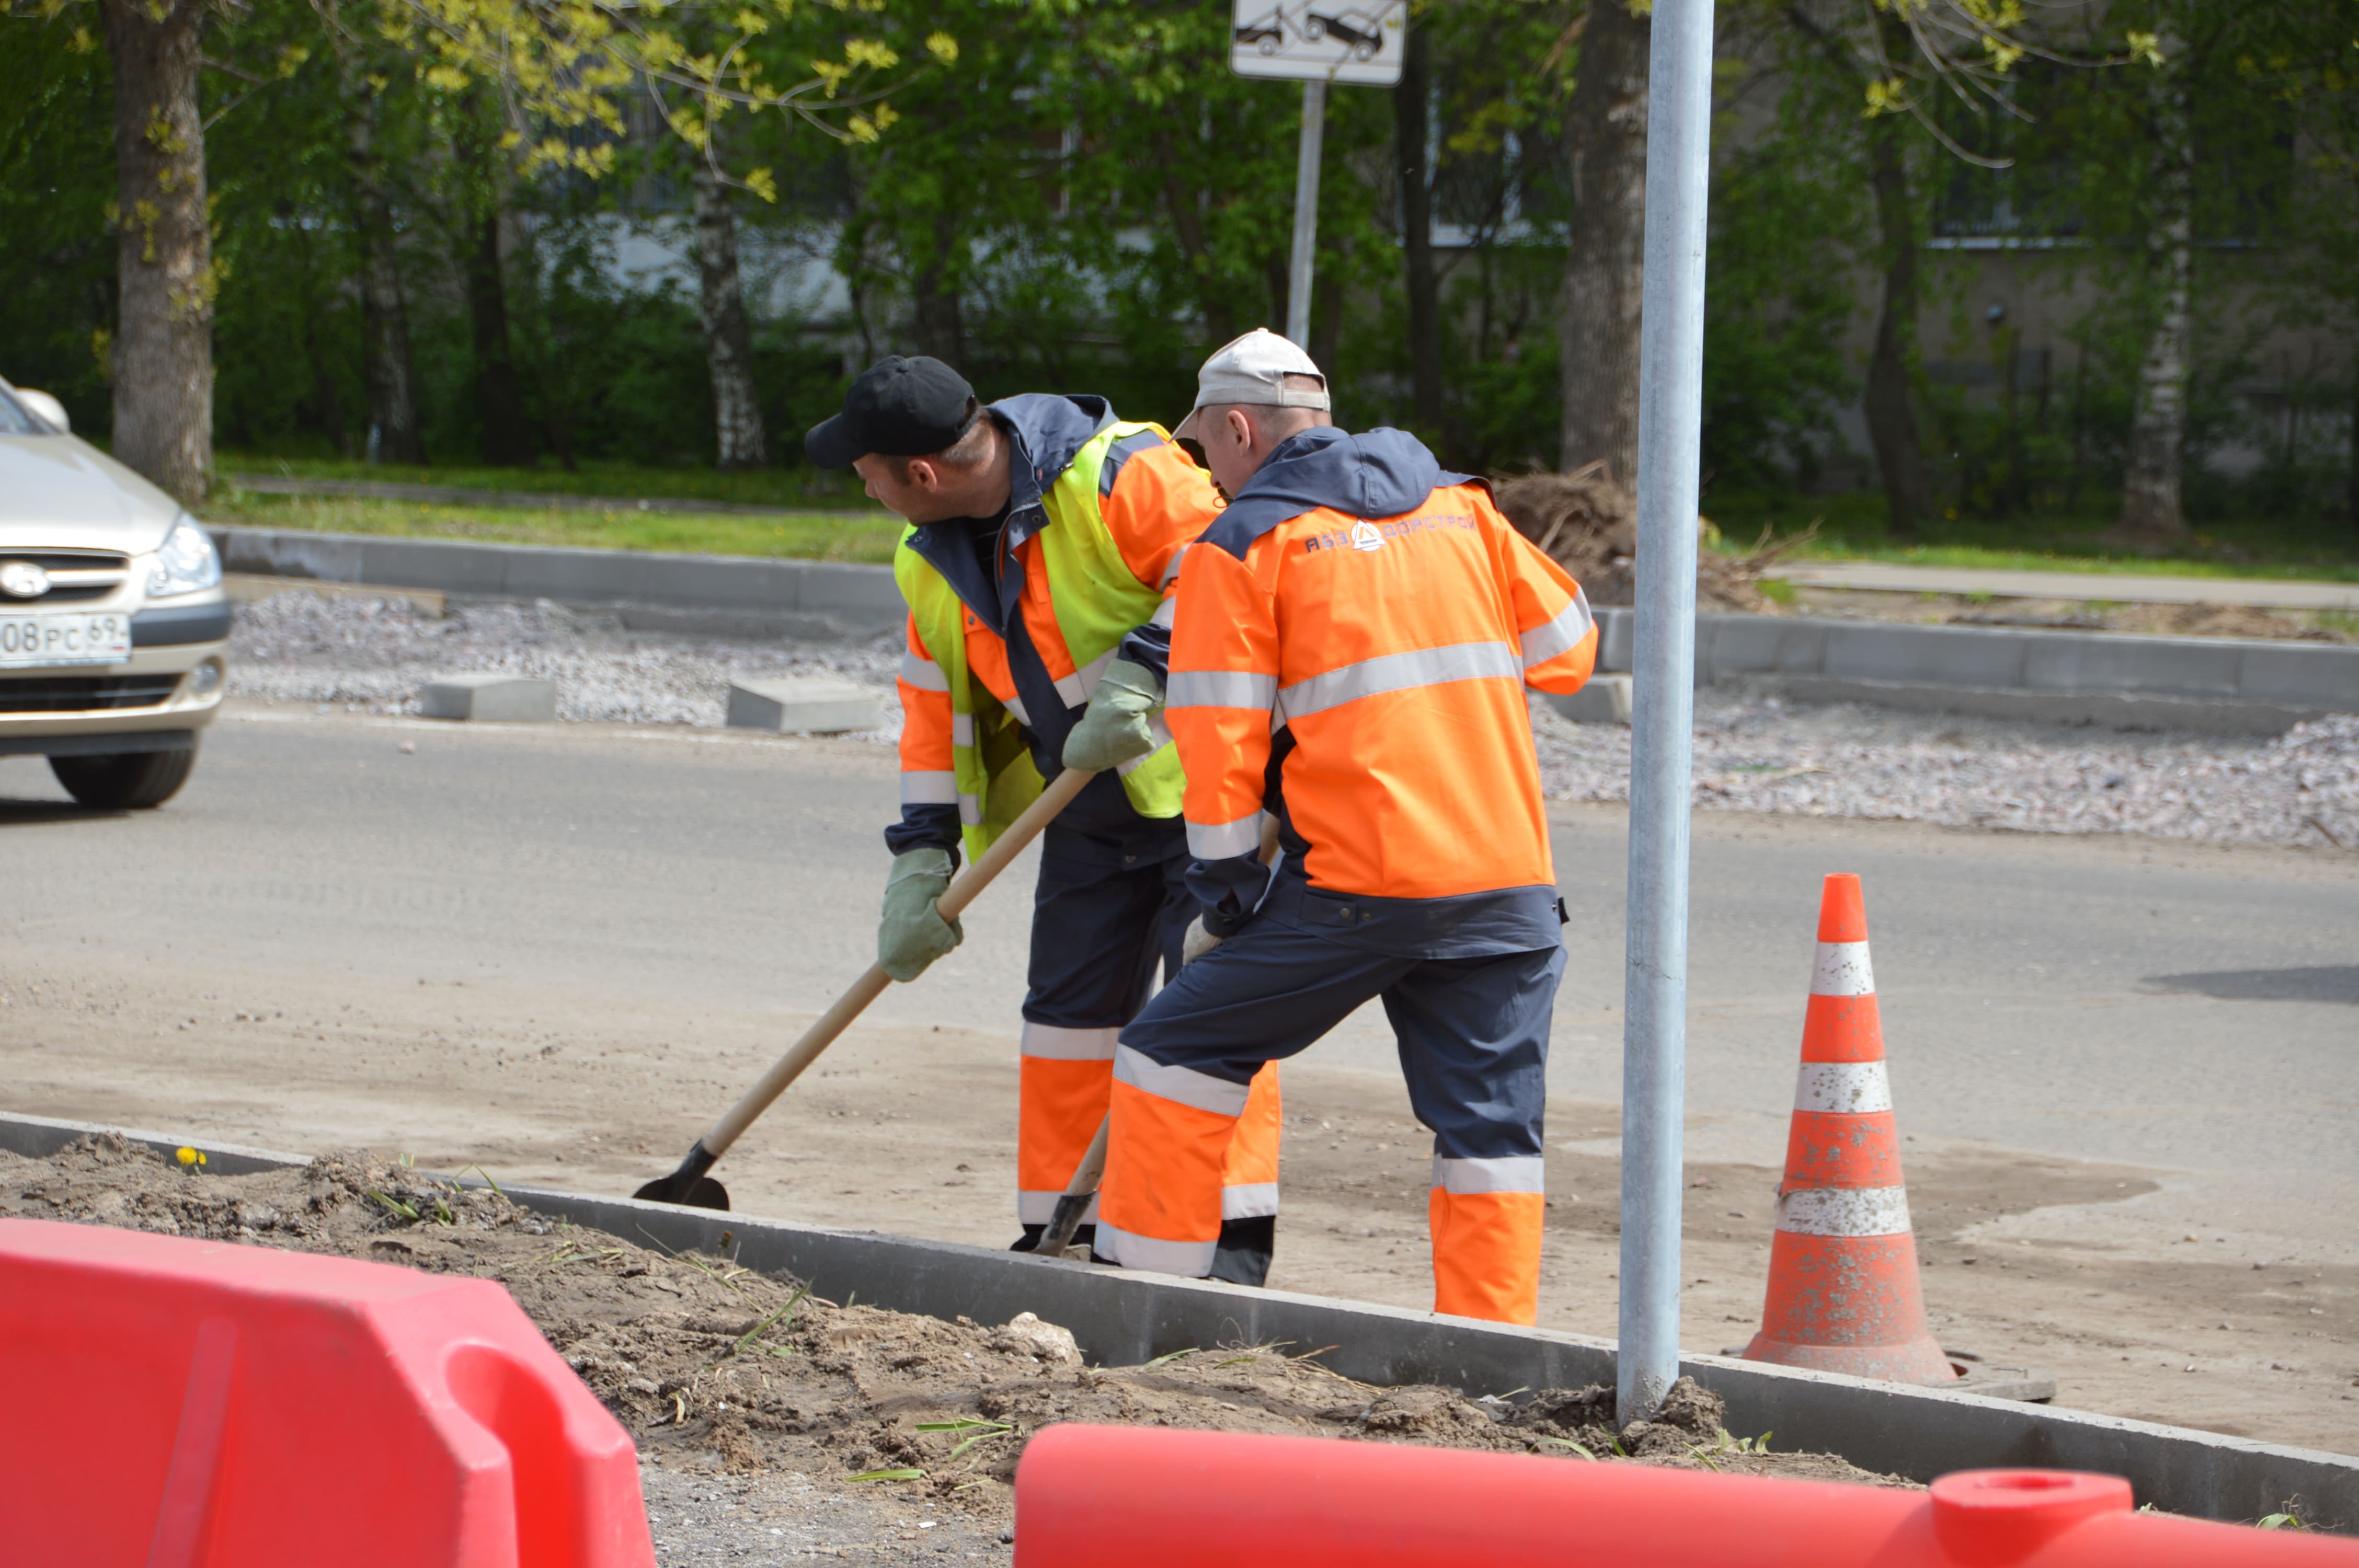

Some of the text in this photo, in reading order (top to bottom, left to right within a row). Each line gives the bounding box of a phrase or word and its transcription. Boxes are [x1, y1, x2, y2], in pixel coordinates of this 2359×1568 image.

[1305, 514, 1477, 553] АБЗ ДОРСТРОЙ
[0, 618, 117, 652] 08РС 69
